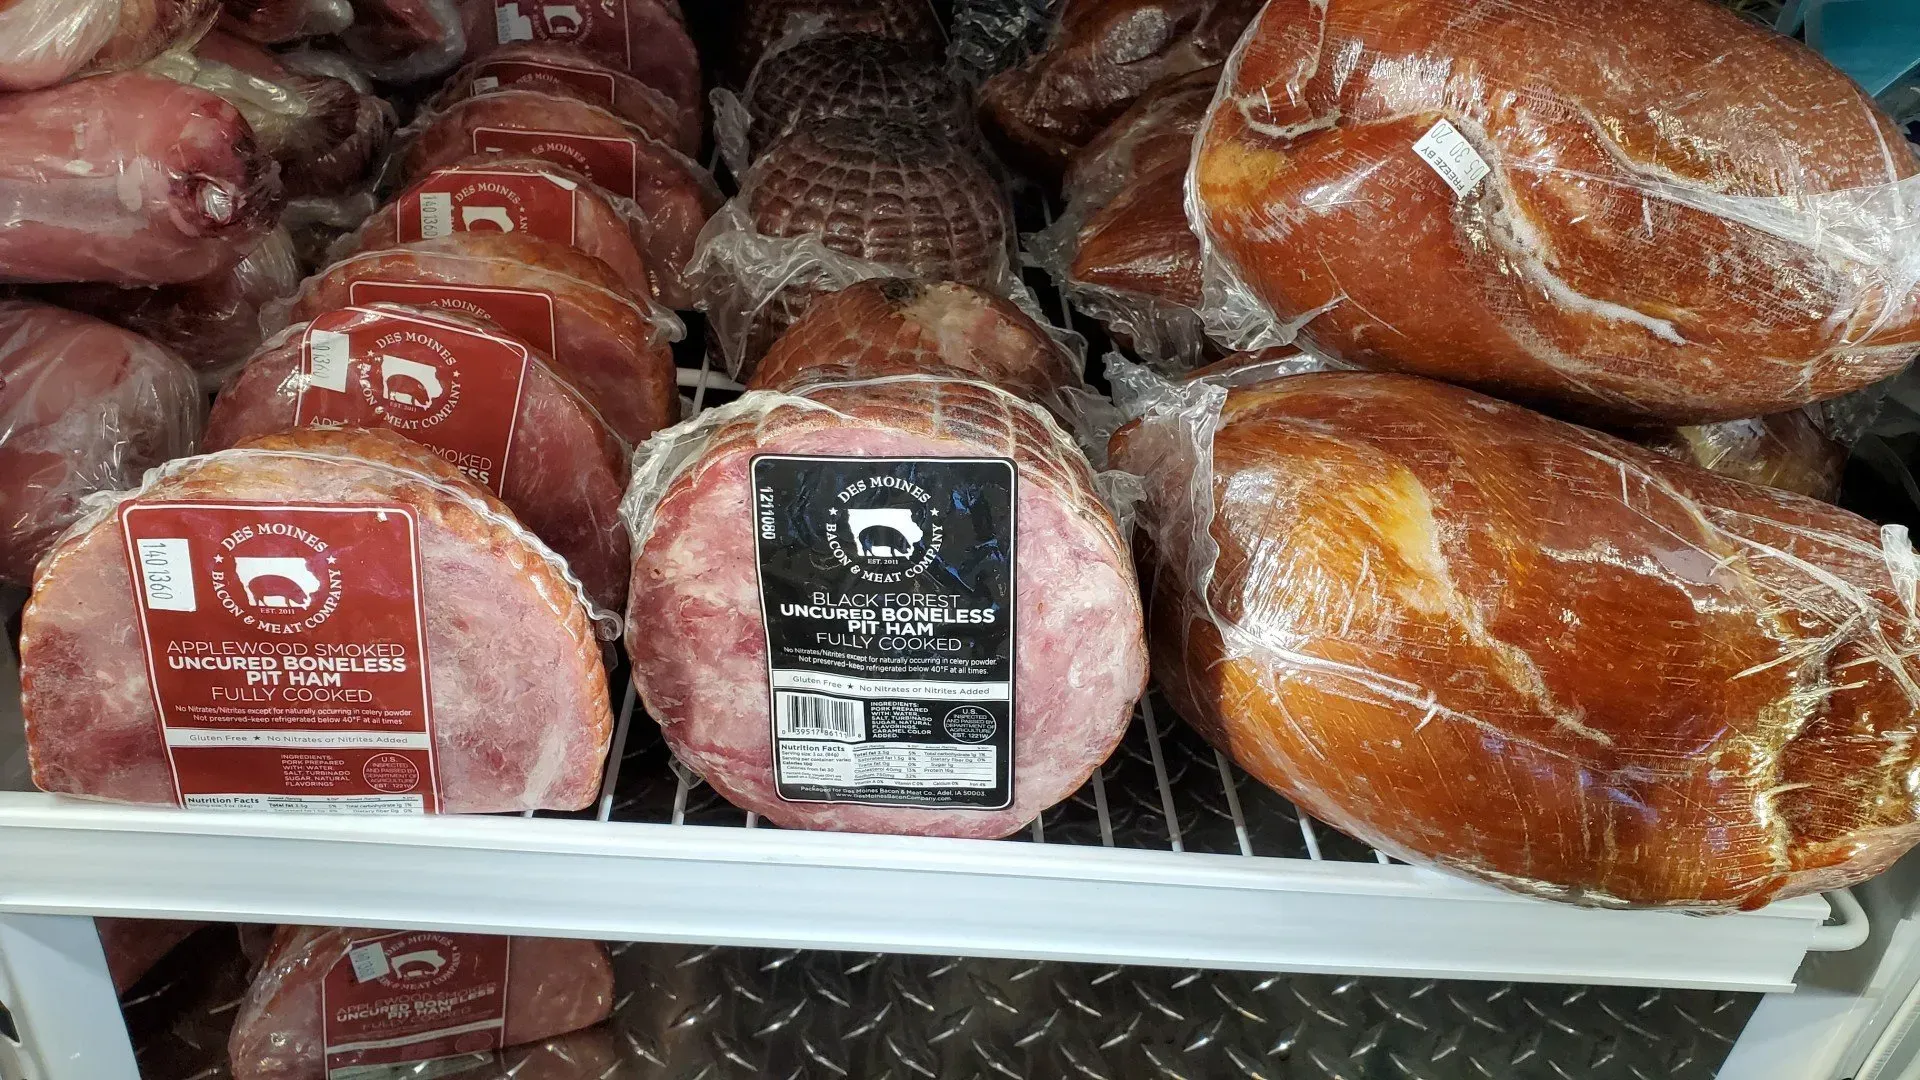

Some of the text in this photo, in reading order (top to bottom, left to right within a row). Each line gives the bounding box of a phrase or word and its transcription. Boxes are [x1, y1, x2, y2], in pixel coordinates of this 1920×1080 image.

[531, 142, 586, 163] ES MOINES
[1431, 123, 1485, 181] 05 30 20
[1421, 146, 1465, 191] FREEZE BY
[455, 182, 521, 204] DES MOINES
[376, 332, 457, 366] DES MOINES
[384, 412, 419, 430] MEAT
[421, 381, 461, 428] COMPANY
[838, 476, 932, 504] DES MOINES
[760, 486, 776, 541] 1211080
[221, 523, 329, 553] DES MOINES
[826, 523, 943, 583] BACON & MEAT COMPANY
[212, 569, 342, 634] BACON & MEAT COMPANY
[813, 591, 961, 608] BLACK FOREST
[780, 604, 996, 624] UNCURED BONELESS
[848, 620, 934, 636] PIT HAM
[167, 640, 405, 657] APPLEWOOD SMOKED
[816, 632, 961, 651] FULLY COOKED
[168, 656, 407, 673] UNCURED BONELESS
[794, 647, 845, 659] Nitrates/Nitrites
[846, 653, 868, 663] except
[880, 656, 908, 665] naturally
[909, 656, 940, 665] occurring
[949, 657, 969, 666] celery
[971, 658, 997, 666] powder.
[799, 655, 811, 663] Not
[812, 657, 864, 671] preserved-keep
[866, 665, 906, 673] refrigerated
[968, 667, 988, 675] times.
[246, 671, 341, 687] PIT HAM
[792, 675, 821, 684] Gluten
[823, 680, 842, 688] Free
[925, 686, 957, 694] Nitrites
[211, 686, 373, 703] FULLY COOKED
[188, 705, 246, 714] Nitrates/Nitrites
[247, 707, 272, 715] except
[285, 708, 315, 716] naturally
[317, 708, 352, 716] occurring
[361, 709, 383, 717] celery
[384, 709, 412, 717] powder.
[210, 715, 269, 723] preserved-keep
[272, 716, 316, 724] refrigerated
[189, 734, 223, 742] Gluten
[408, 933, 454, 947] MOINES
[336, 986, 495, 1022] UNCURED BONELESS
[387, 1006, 451, 1020] PIT HAM
